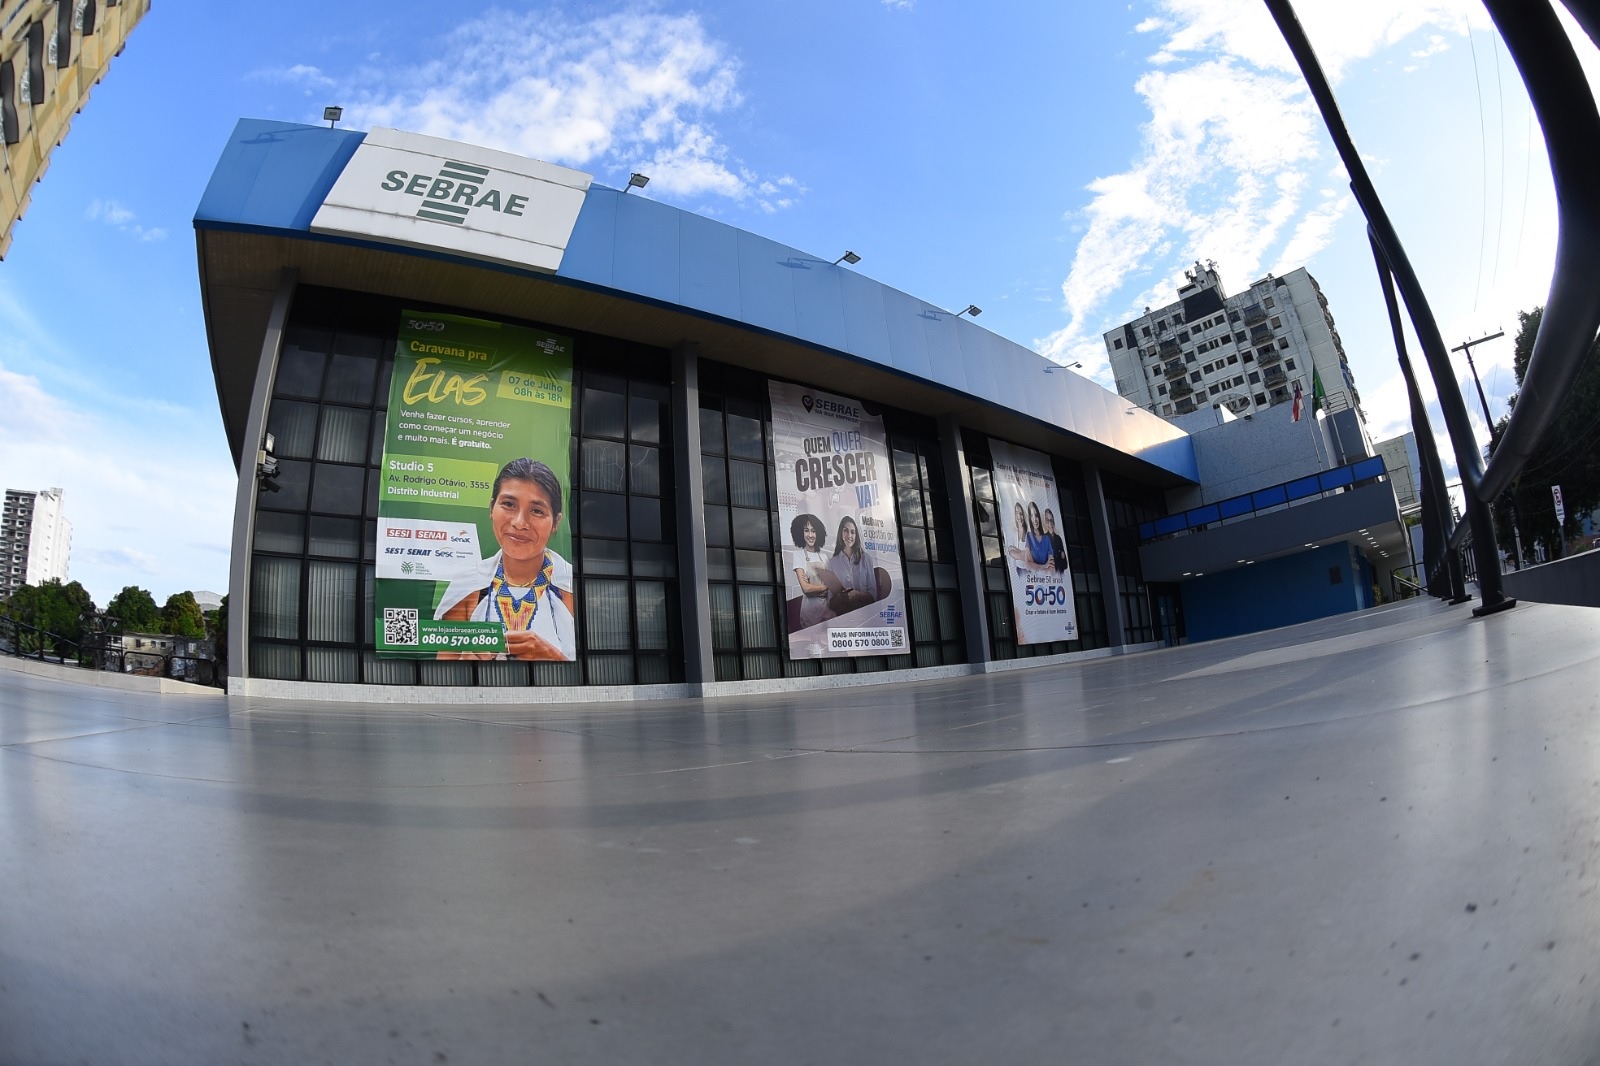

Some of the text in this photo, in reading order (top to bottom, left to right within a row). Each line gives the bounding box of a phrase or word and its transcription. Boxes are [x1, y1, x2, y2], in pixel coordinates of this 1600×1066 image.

[380, 170, 529, 217] SEBRAE
[410, 340, 487, 361] Caravana pra
[535, 340, 565, 353] SEBRAE
[508, 375, 563, 393] 07 de Julho
[513, 386, 563, 403] 08h às 18h
[815, 398, 860, 418] SEBRAE
[400, 409, 511, 430] Venha fazer cursos, aprender
[399, 422, 504, 441] como começar um negócio
[404, 433, 428, 443] muito
[429, 435, 450, 445] mais.
[451, 434, 457, 446] É
[458, 437, 492, 450] gratuito.
[803, 430, 863, 457] QUEM QUER
[389, 460, 434, 472] Studio 5
[795, 451, 877, 492] CRESCER
[388, 474, 490, 490] Av. Rodrigo Otávio, 3555
[387, 486, 460, 500] Distrito Industrial
[855, 483, 880, 509] VAI!
[388, 528, 410, 538] SESI
[417, 529, 446, 540] SENAI
[863, 529, 868, 538] a
[385, 547, 405, 555] SEST
[406, 547, 432, 557] SENAT
[434, 549, 454, 558] Sesc
[1026, 574, 1046, 583] Sebrae
[1025, 585, 1066, 606] 50+50
[421, 634, 498, 646] 0800 570 0800
[832, 638, 890, 648] 0800 570 0800
[848, 630, 889, 639] INFORMAÇÕES
